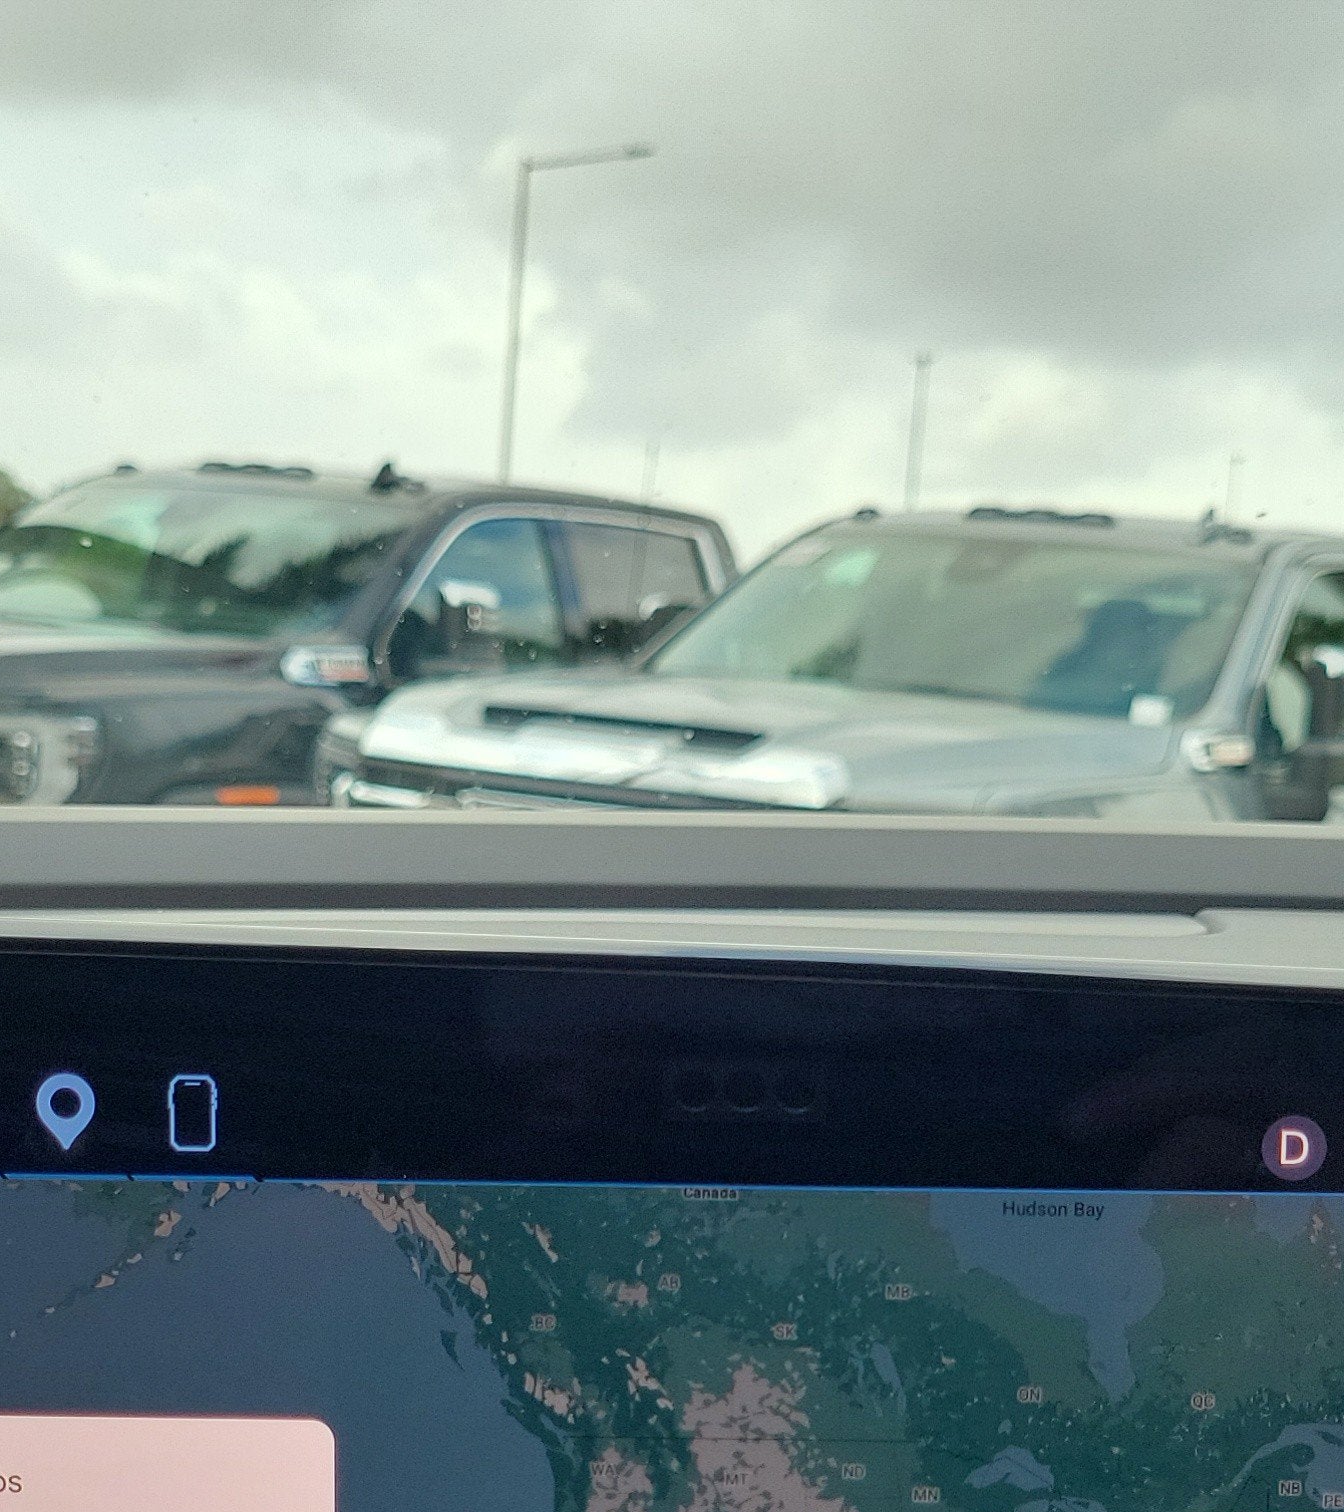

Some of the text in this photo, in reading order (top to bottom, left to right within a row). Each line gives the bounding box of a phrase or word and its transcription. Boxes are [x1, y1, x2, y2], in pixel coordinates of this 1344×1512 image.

[1280, 1130, 1310, 1166] D
[683, 1187, 738, 1200] Canada
[1003, 1201, 1104, 1220] Hudson Bay
[659, 1275, 680, 1290] AB
[886, 1285, 912, 1300] MB
[534, 1315, 555, 1331] BC
[773, 1324, 794, 1340] SK
[1018, 1388, 1041, 1403] ON
[1191, 1394, 1215, 1410] QC
[592, 1463, 615, 1477] WA
[843, 1465, 864, 1479] ND
[726, 1472, 748, 1485] MT
[912, 1487, 939, 1502] MN
[1279, 1480, 1301, 1495] NB
[1324, 1494, 1344, 1508] PE
